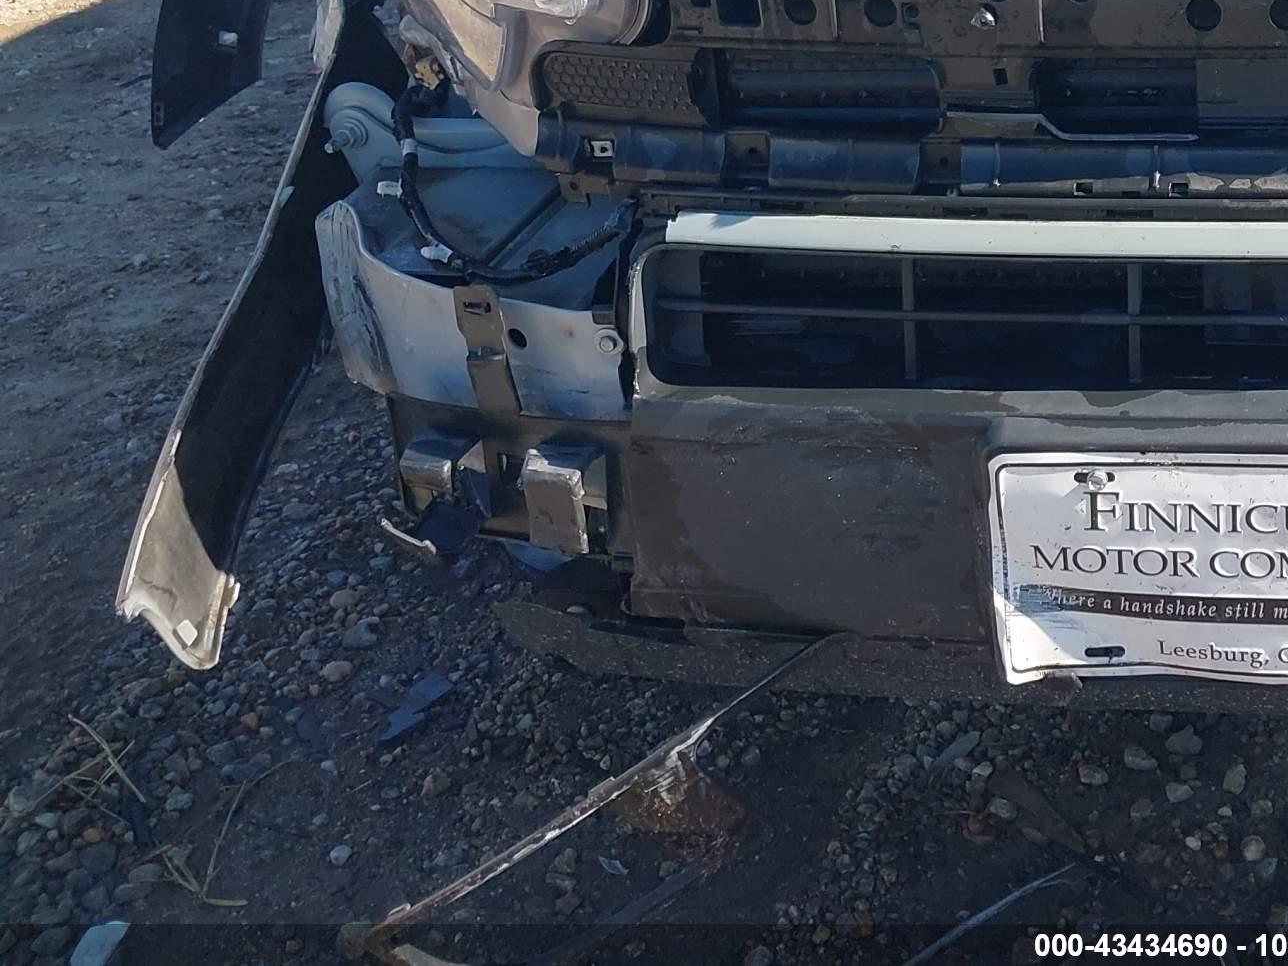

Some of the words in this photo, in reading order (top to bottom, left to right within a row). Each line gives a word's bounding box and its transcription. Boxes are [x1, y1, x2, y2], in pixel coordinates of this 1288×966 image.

[1032, 545, 1200, 578] MOTOR
[1103, 599, 1112, 609] a
[1120, 597, 1217, 617] handshake
[1225, 602, 1266, 620] still
[1158, 639, 1269, 668] Leesburg,
